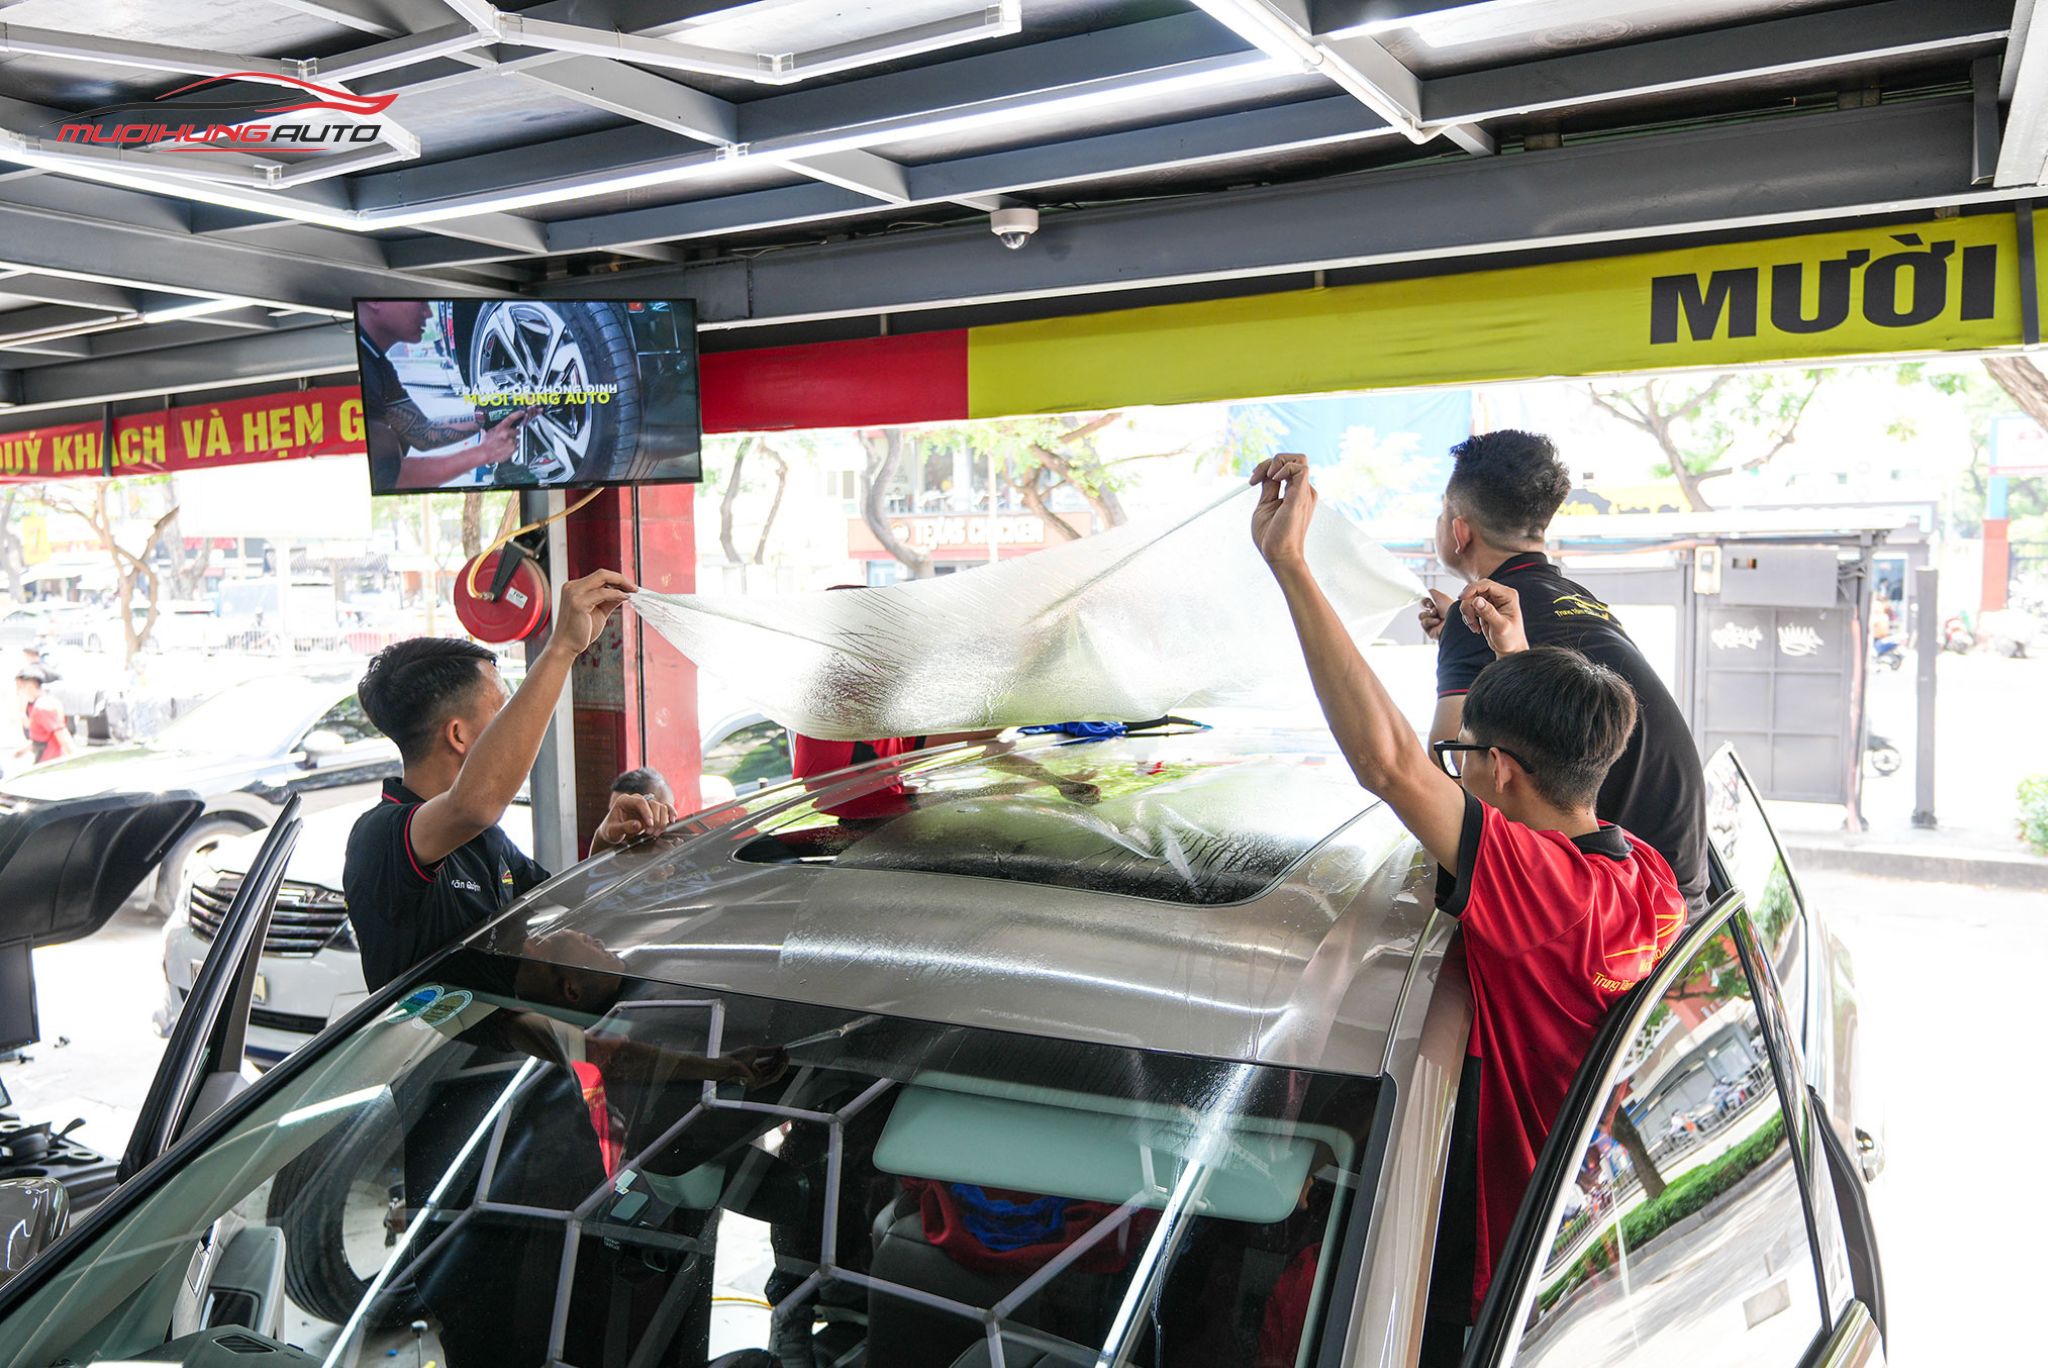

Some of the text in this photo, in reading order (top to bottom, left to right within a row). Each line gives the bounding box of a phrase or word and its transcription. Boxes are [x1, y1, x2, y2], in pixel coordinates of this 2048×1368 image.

[1650, 233, 1997, 345] MƯỜI
[565, 391, 610, 405] AUTO
[0, 432, 42, 475] UÝ
[182, 408, 231, 459] VÀ
[242, 402, 323, 459] HẸN
[913, 516, 1044, 549] TEXAS CHCKEN
[1593, 972, 1621, 992] Trung
